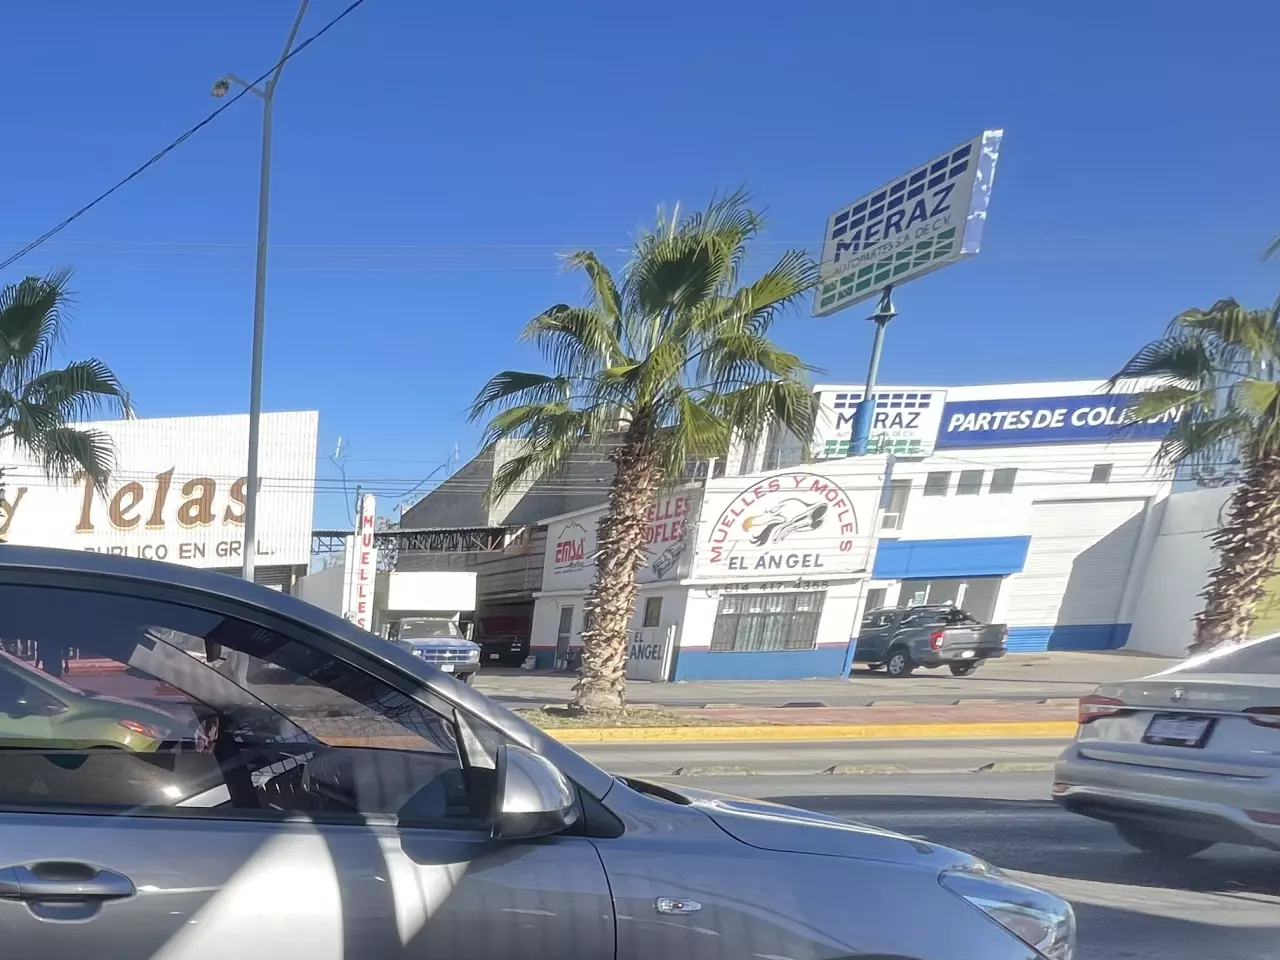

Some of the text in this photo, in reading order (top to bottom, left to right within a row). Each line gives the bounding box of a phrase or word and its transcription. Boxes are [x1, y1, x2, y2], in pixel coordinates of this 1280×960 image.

[834, 182, 956, 263] MERAZ
[915, 223, 931, 239] DE
[836, 412, 921, 430] MRAZ
[947, 408, 1031, 432] PARTES
[1032, 408, 1068, 428] DE
[73, 466, 262, 532] Telas
[710, 479, 780, 563] MUELLES
[793, 476, 807, 488] Y
[179, 542, 205, 559] EN
[216, 541, 274, 557] GRL.
[356, 515, 373, 629] MUELLES
[728, 556, 748, 570] EL
[634, 631, 644, 643] EL
